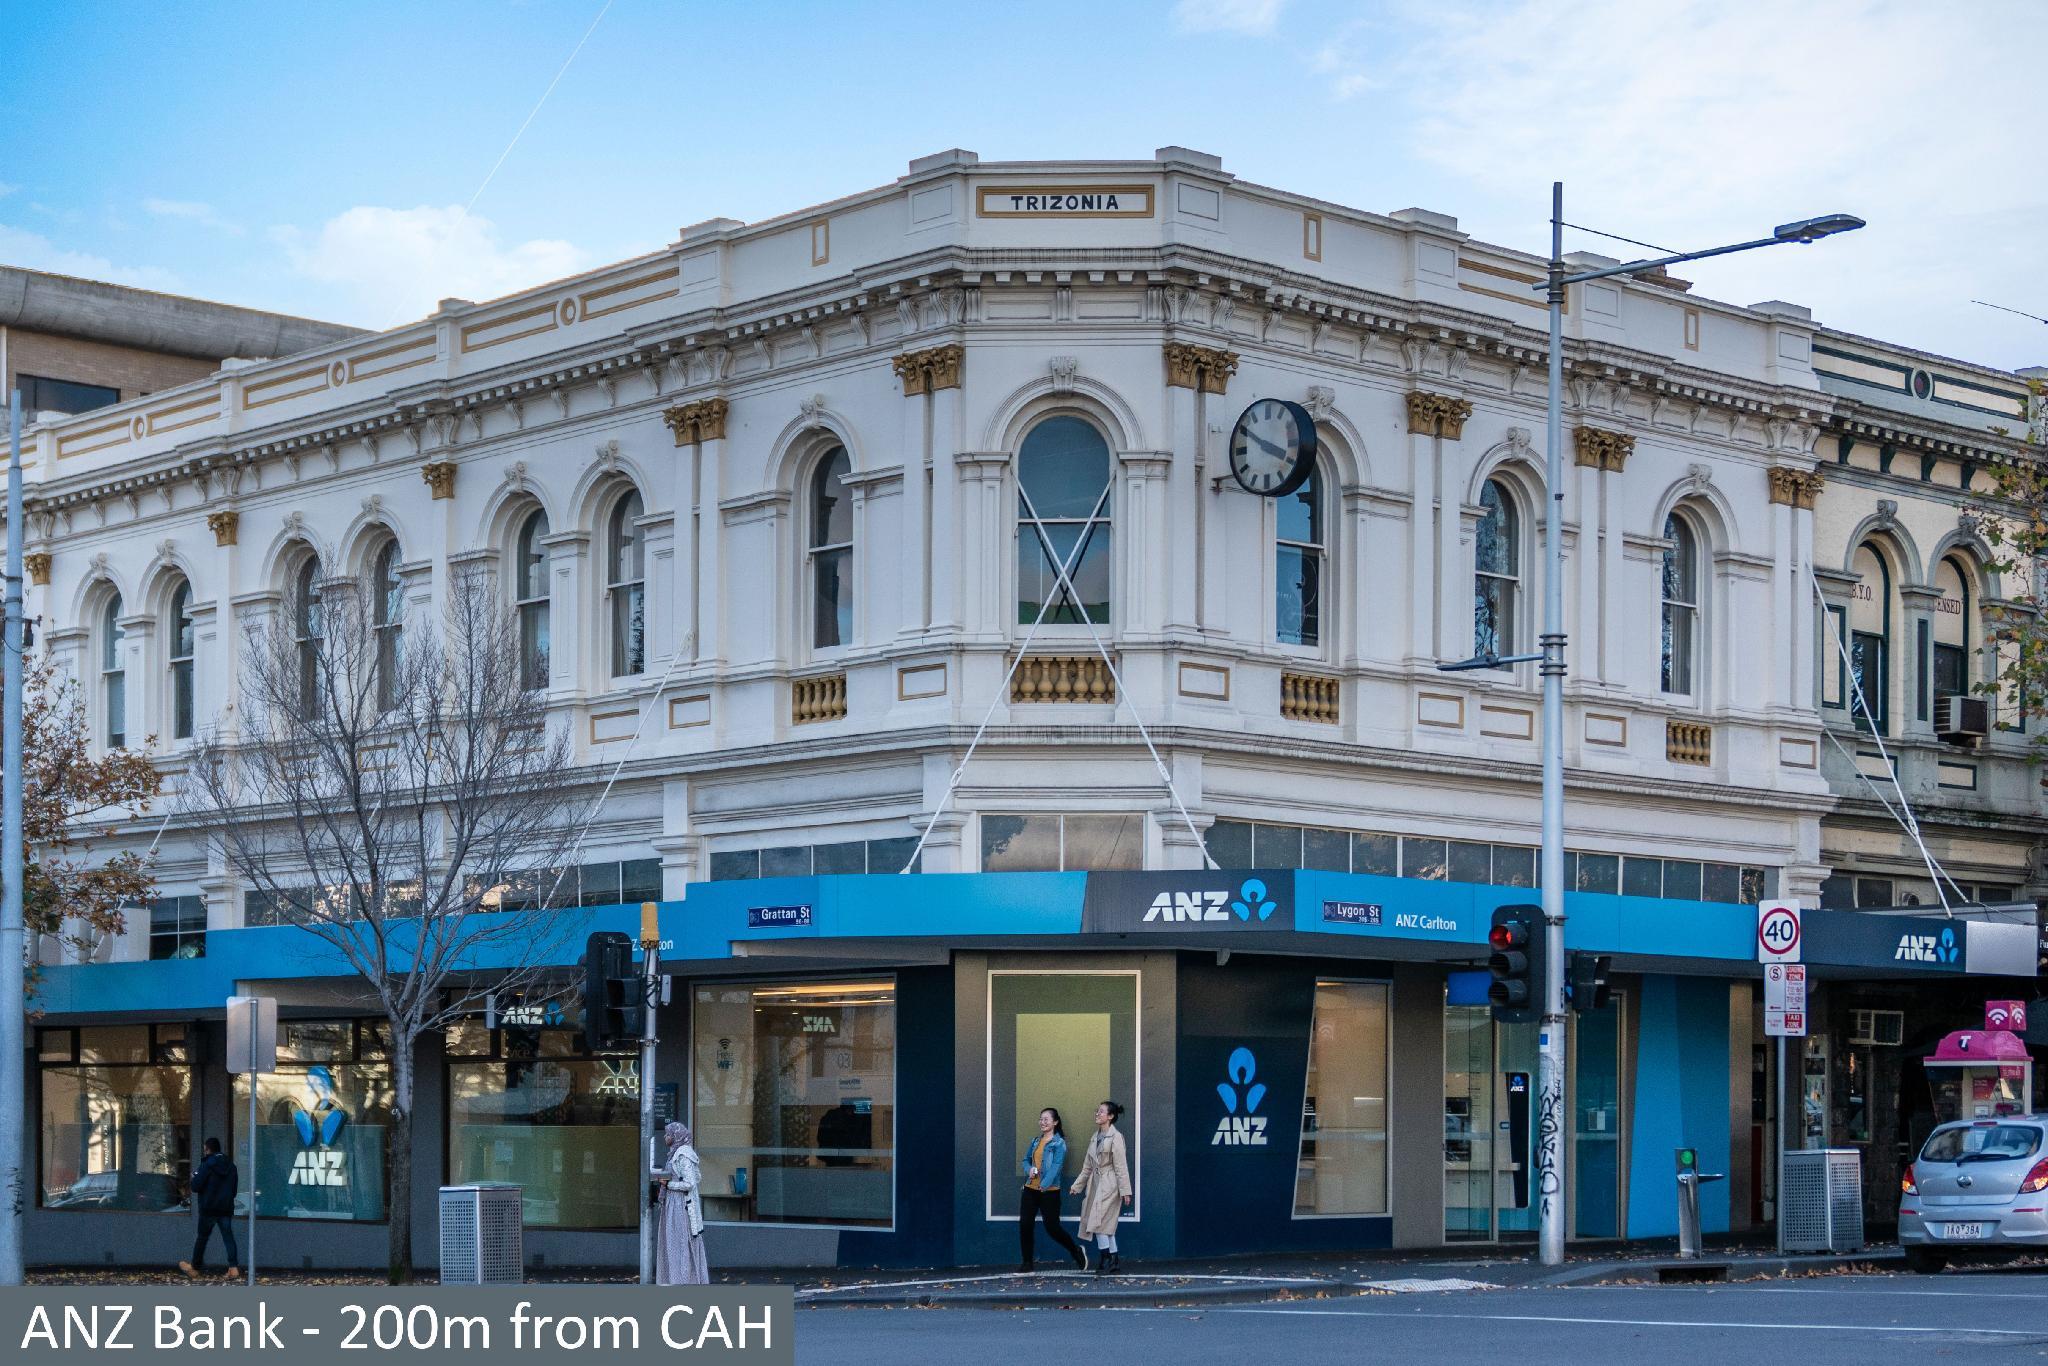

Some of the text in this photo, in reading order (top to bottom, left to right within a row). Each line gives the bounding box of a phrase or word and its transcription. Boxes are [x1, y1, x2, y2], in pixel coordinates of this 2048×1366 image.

[1010, 194, 1119, 211] TRIZONIA
[761, 906, 810, 920] Grattan St
[1142, 891, 1229, 922] ANZ
[1337, 904, 1380, 918] Lygon St
[1395, 914, 1457, 931] ANZ Carlton
[1765, 920, 1794, 942] 40
[1895, 934, 1937, 962] ANZ
[501, 1007, 543, 1025] ANZ
[596, 1076, 639, 1099] AN
[1211, 1117, 1268, 1145] ANZ
[288, 1151, 343, 1186] ANZ
